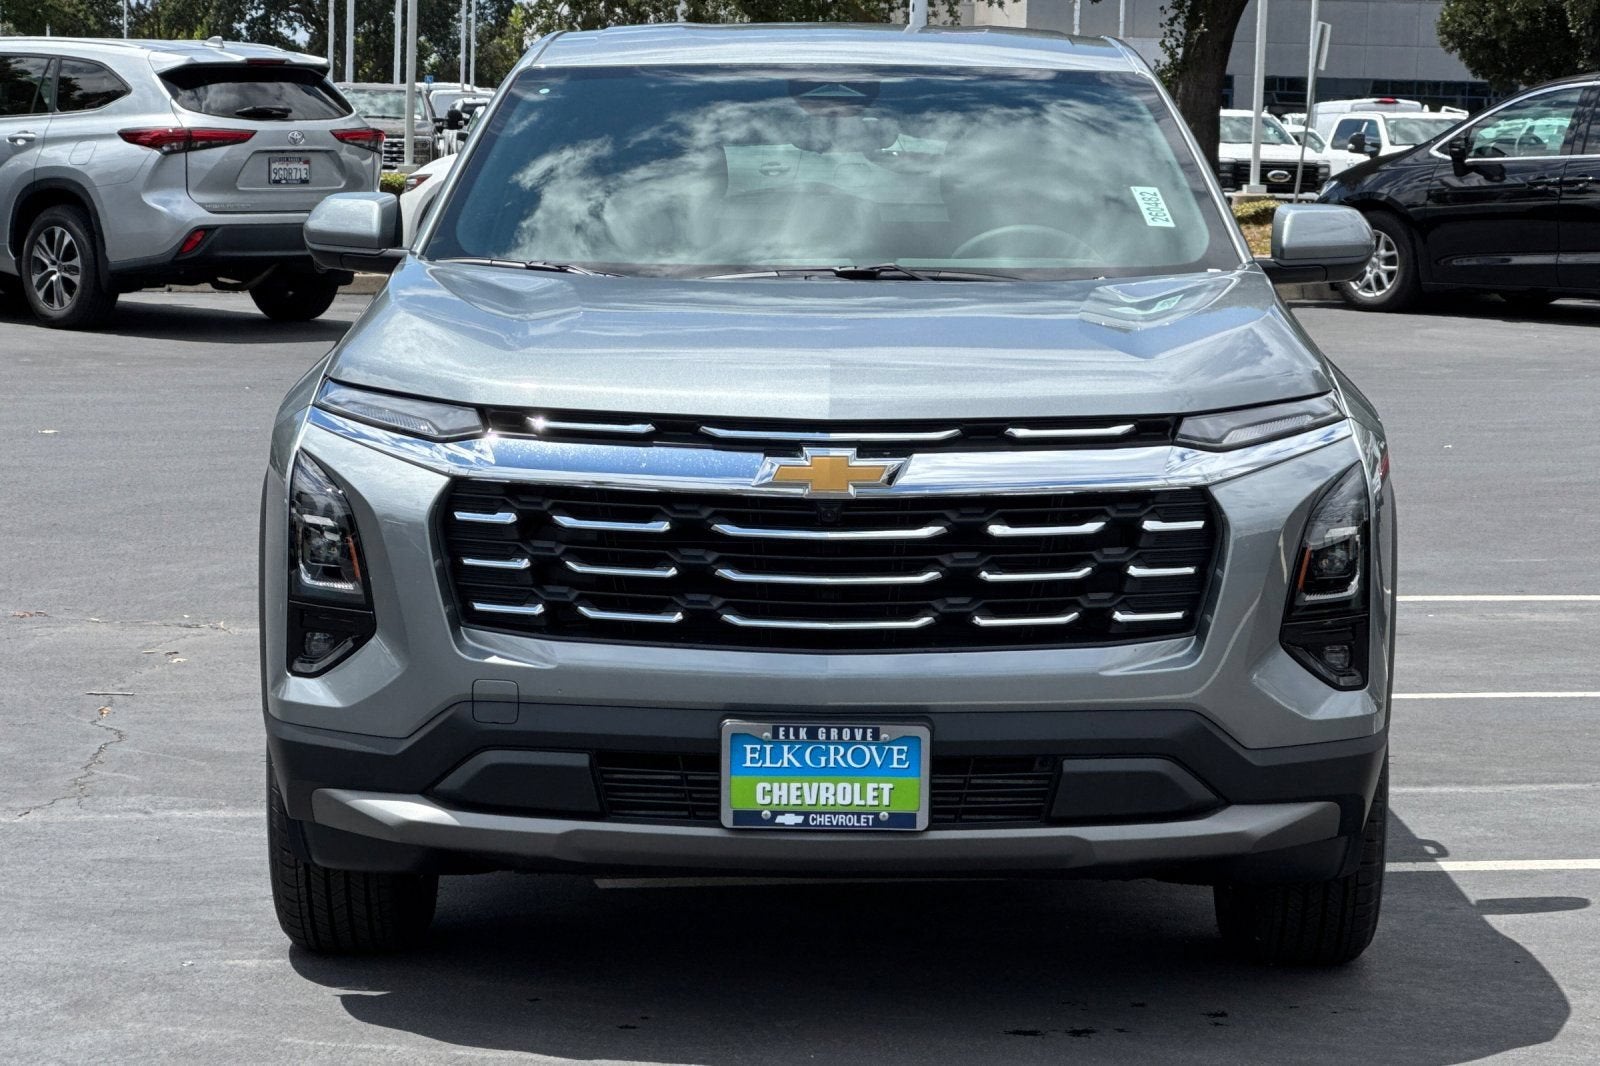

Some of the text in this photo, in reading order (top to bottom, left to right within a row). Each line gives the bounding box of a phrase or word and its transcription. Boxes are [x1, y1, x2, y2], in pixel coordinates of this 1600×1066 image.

[1139, 191, 1170, 222] 260482
[779, 726, 873, 741] ELK GROVE
[742, 744, 910, 769] ELK GROVE
[755, 781, 894, 807] CHEVROLET
[809, 814, 874, 826] CHEVROLET
